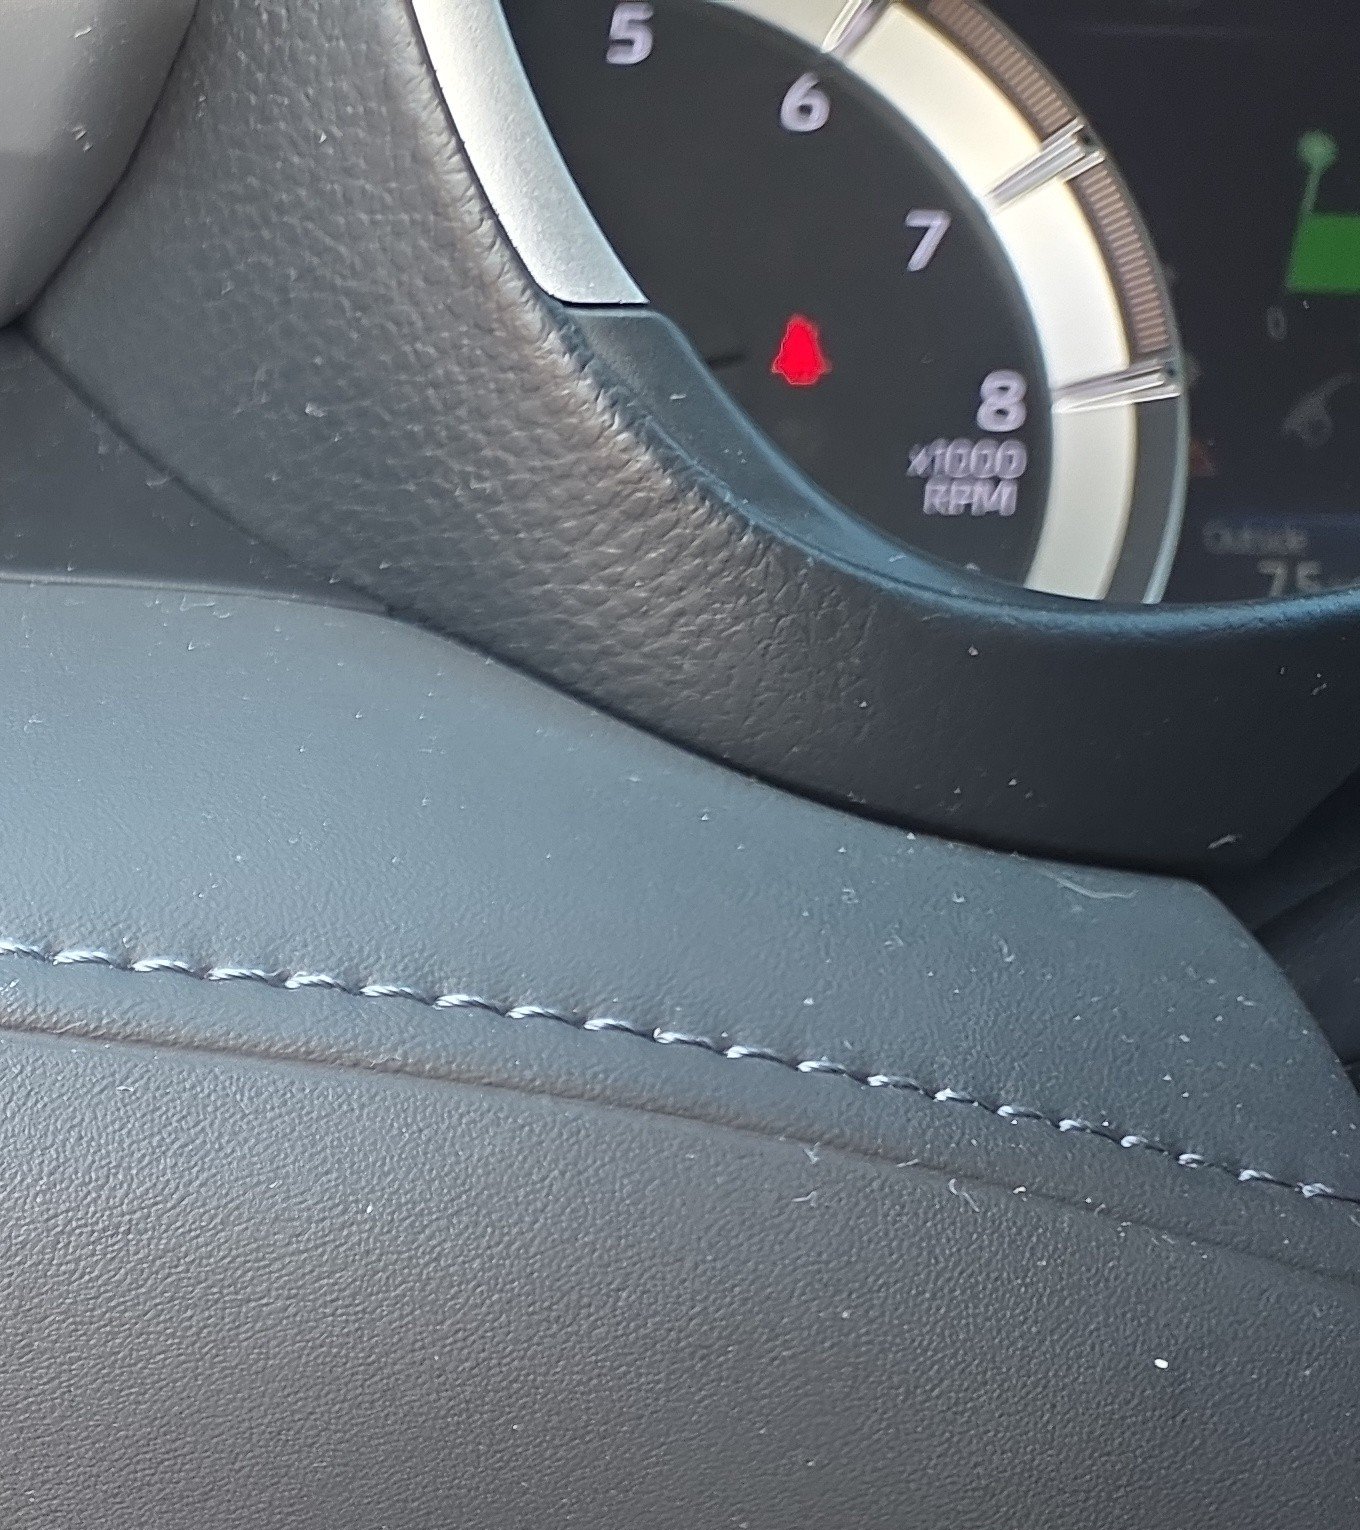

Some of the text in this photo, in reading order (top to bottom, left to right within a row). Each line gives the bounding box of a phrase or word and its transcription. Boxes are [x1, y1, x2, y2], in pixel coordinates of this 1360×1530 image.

[606, 1, 654, 65] 5
[780, 71, 830, 132] 6
[904, 208, 952, 272] 7
[976, 369, 1027, 433] 8
[922, 474, 1018, 516] RPM
